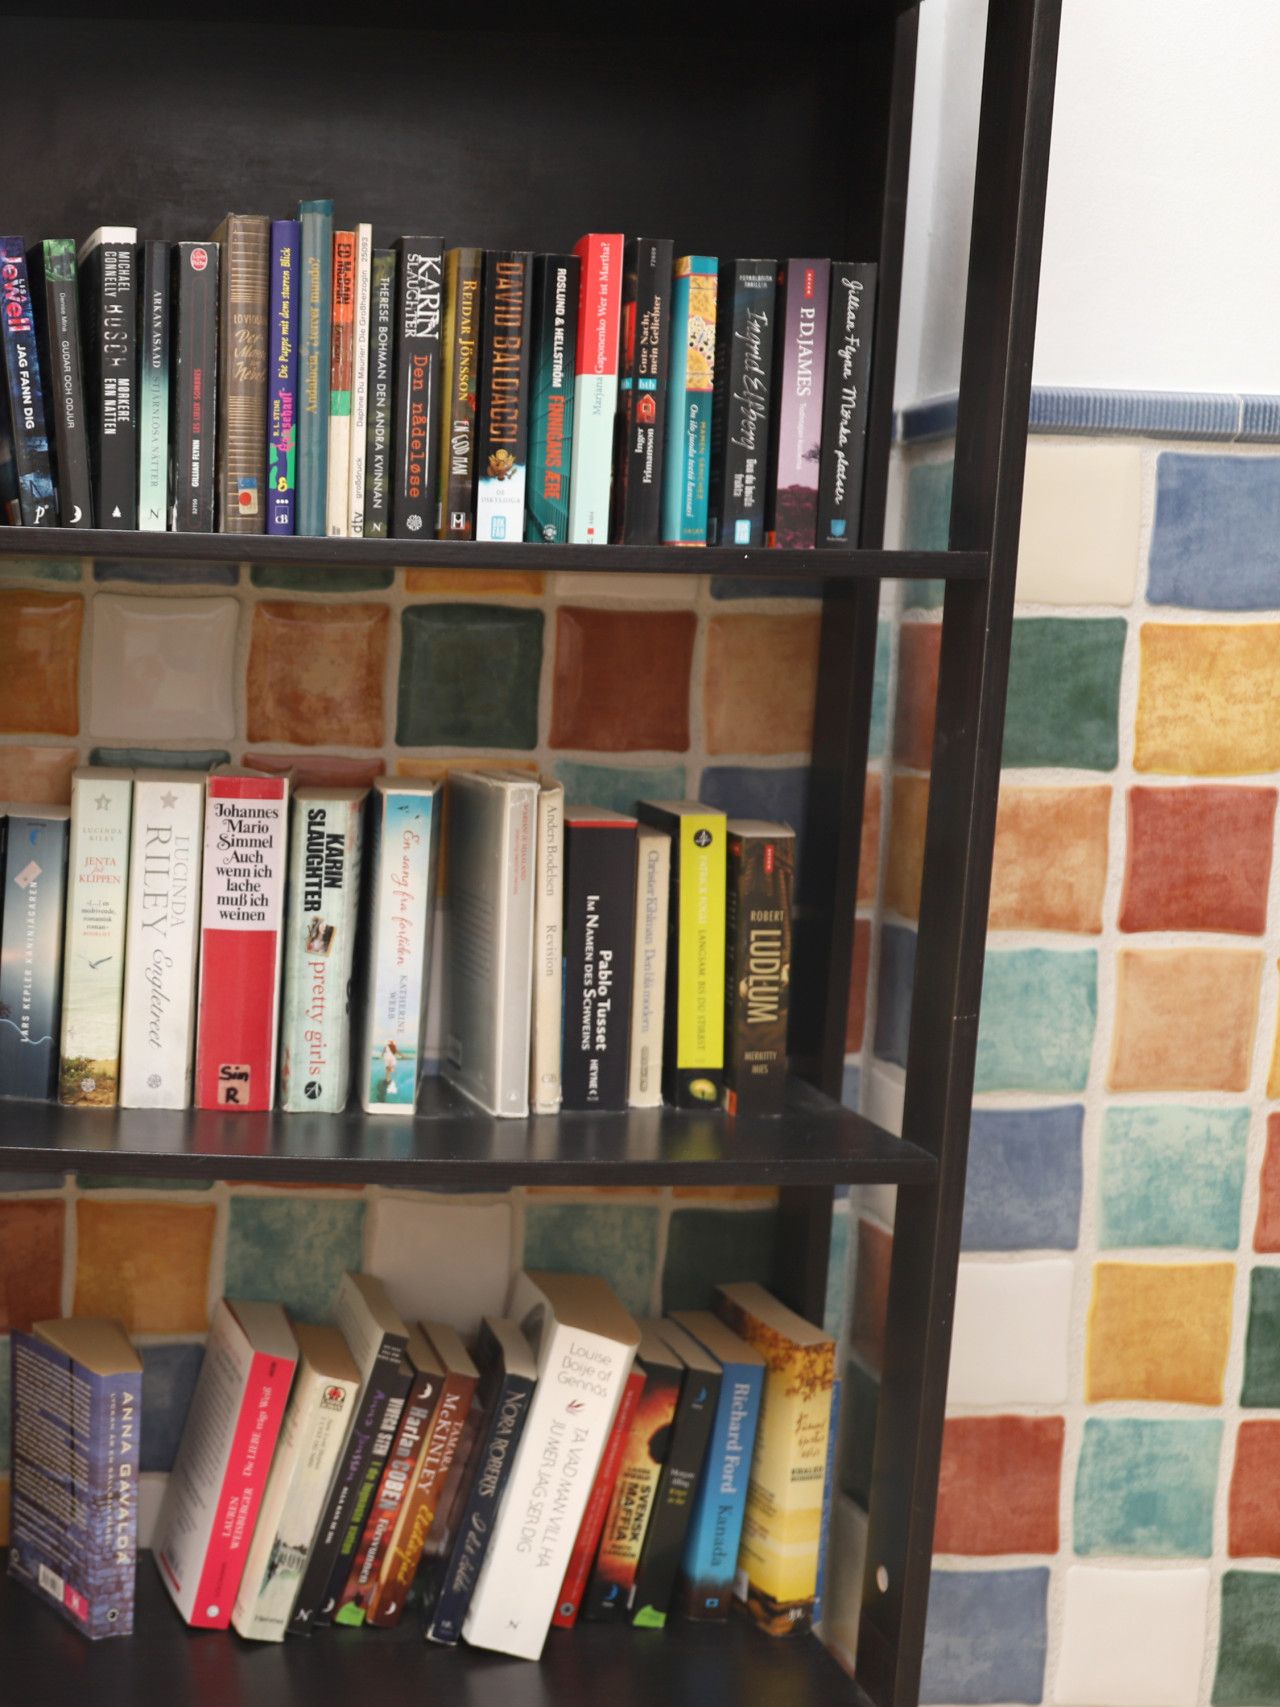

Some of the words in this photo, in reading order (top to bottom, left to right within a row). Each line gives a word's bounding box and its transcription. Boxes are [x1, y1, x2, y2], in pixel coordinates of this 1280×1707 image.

[104, 251, 117, 298] CONNELLY
[117, 251, 130, 292] MICHAEL
[153, 291, 162, 329] ARKAN
[378, 277, 390, 322] THERESE
[404, 253, 420, 339] SLAUGHTER
[417, 255, 441, 340] KARIN
[494, 262, 523, 328] DAVID
[556, 267, 567, 317] ROSLUND
[597, 296, 608, 317] Wer
[16, 343, 28, 367] JAG
[62, 340, 71, 374] GUDAR
[376, 326, 388, 380] BOHMAN
[650, 349, 659, 374] mein
[19, 368, 32, 405] FANN
[64, 375, 72, 396] OCH
[104, 378, 116, 398] ENN
[413, 356, 428, 391] Den
[489, 336, 522, 443] BALDACCI
[376, 383, 387, 407] DEN
[23, 406, 35, 430] DIG
[104, 400, 116, 434] NATTEN
[374, 411, 386, 451] ANDRA
[192, 440, 201, 461] FLYNN
[191, 463, 200, 487] GILLIAN
[372, 454, 385, 508] KVINNAN
[352, 511, 364, 534] dtv
[215, 803, 279, 819] Johannes
[222, 819, 270, 834] Mario
[217, 834, 274, 851] Simmel
[223, 849, 264, 864] Auch
[303, 808, 327, 913] SLAUGHTER
[324, 833, 345, 889] KARIN
[141, 823, 172, 937] RILEY
[216, 866, 251, 878] wenn
[253, 864, 273, 878] ich
[226, 878, 261, 893] lache
[219, 909, 266, 922] weinen
[250, 893, 269, 907] ich
[751, 911, 785, 921] ROBERT
[22, 969, 32, 1011] KEPLER
[596, 950, 613, 996] Pablo
[747, 930, 783, 1024] LUDLUM
[304, 961, 327, 1027] pretty
[20, 1014, 29, 1043] LARS
[594, 999, 611, 1052] Tusset
[304, 1030, 327, 1076] girls
[225, 1087, 239, 1104] R
[561, 1354, 597, 1380] Boije
[597, 1367, 613, 1383] af
[568, 1342, 613, 1366] Louise
[120, 1391, 134, 1454] ANNA
[400, 1405, 428, 1456] Harlan
[498, 1390, 526, 1435] NORA
[726, 1382, 751, 1451] Richard
[415, 1392, 461, 1496] McKINLEY
[439, 1419, 464, 1474] TAMARA
[562, 1443, 583, 1476] VAD
[379, 1458, 412, 1510] COBEN
[478, 1437, 510, 1498] ROBERTS
[719, 1453, 740, 1494] Ford
[554, 1476, 575, 1511] MAN
[116, 1463, 131, 1565] GAVALDA
[222, 1495, 239, 1538] LAUREN
